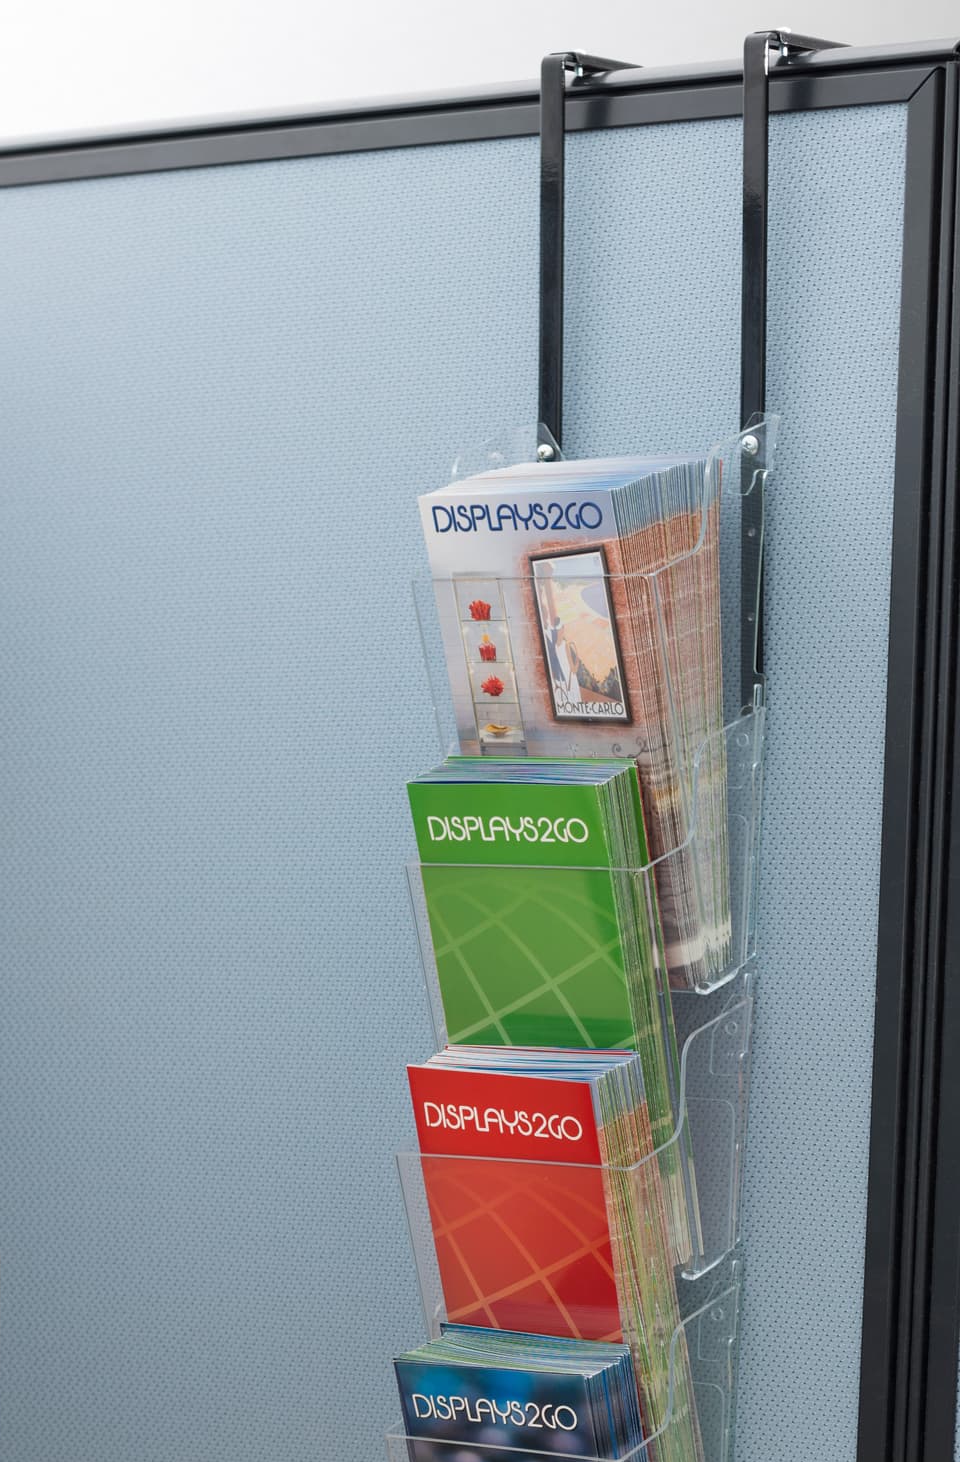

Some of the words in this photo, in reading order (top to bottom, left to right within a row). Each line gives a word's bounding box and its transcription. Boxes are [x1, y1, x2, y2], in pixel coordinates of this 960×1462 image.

[431, 502, 603, 533] DISPLAYS2GO
[557, 700, 625, 716] MONTE-CARLO
[427, 815, 589, 844] DISPLAYS2GO
[423, 1102, 583, 1141] DISPLAYS2GO
[412, 1393, 578, 1432] DISPLAYS2GO
